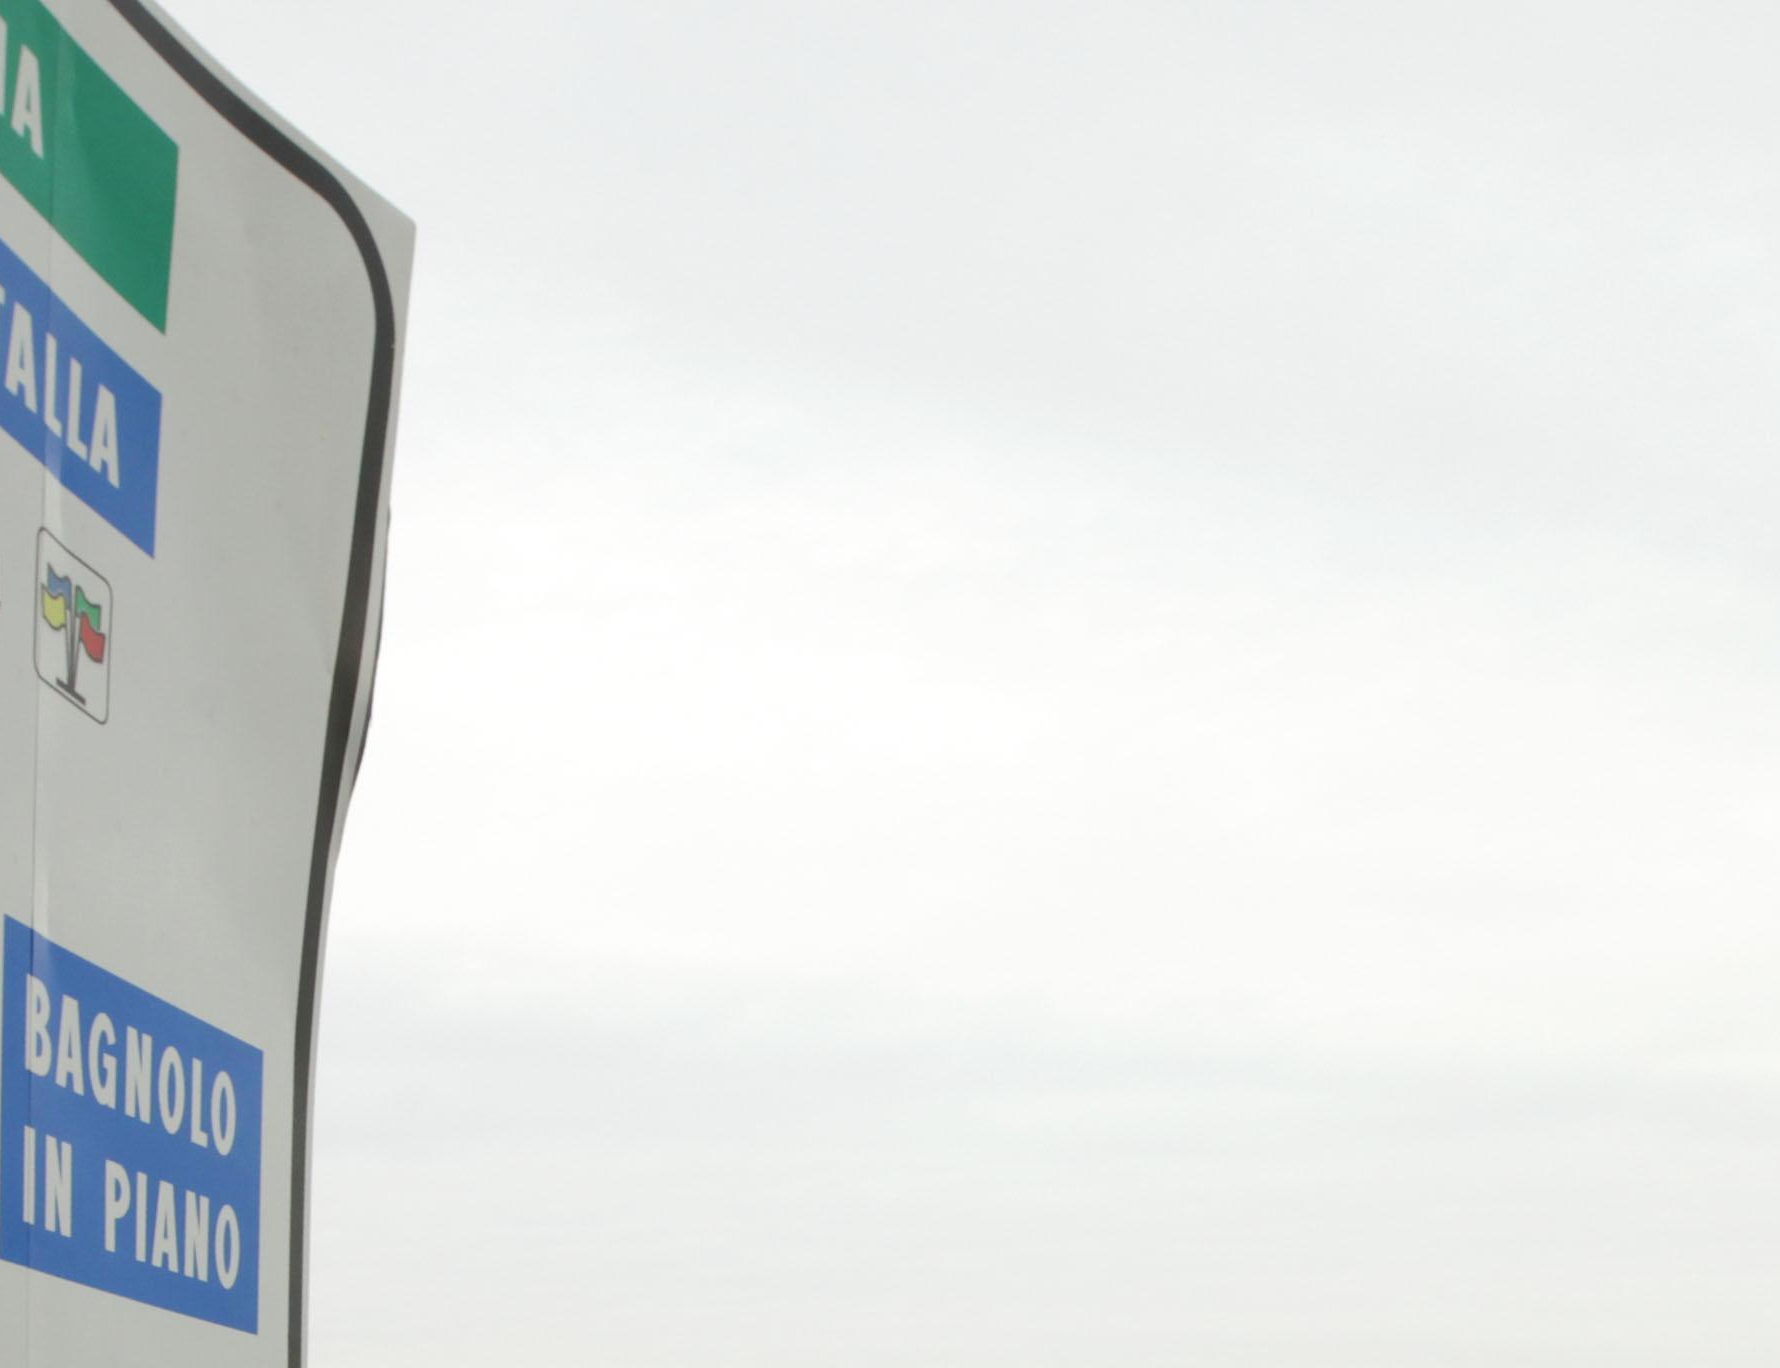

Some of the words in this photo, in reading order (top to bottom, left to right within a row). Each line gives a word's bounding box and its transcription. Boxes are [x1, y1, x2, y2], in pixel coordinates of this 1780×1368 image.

[23, 973, 238, 1157] BAGNOLO
[21, 1124, 74, 1239] IN
[102, 1158, 243, 1292] PIANO
